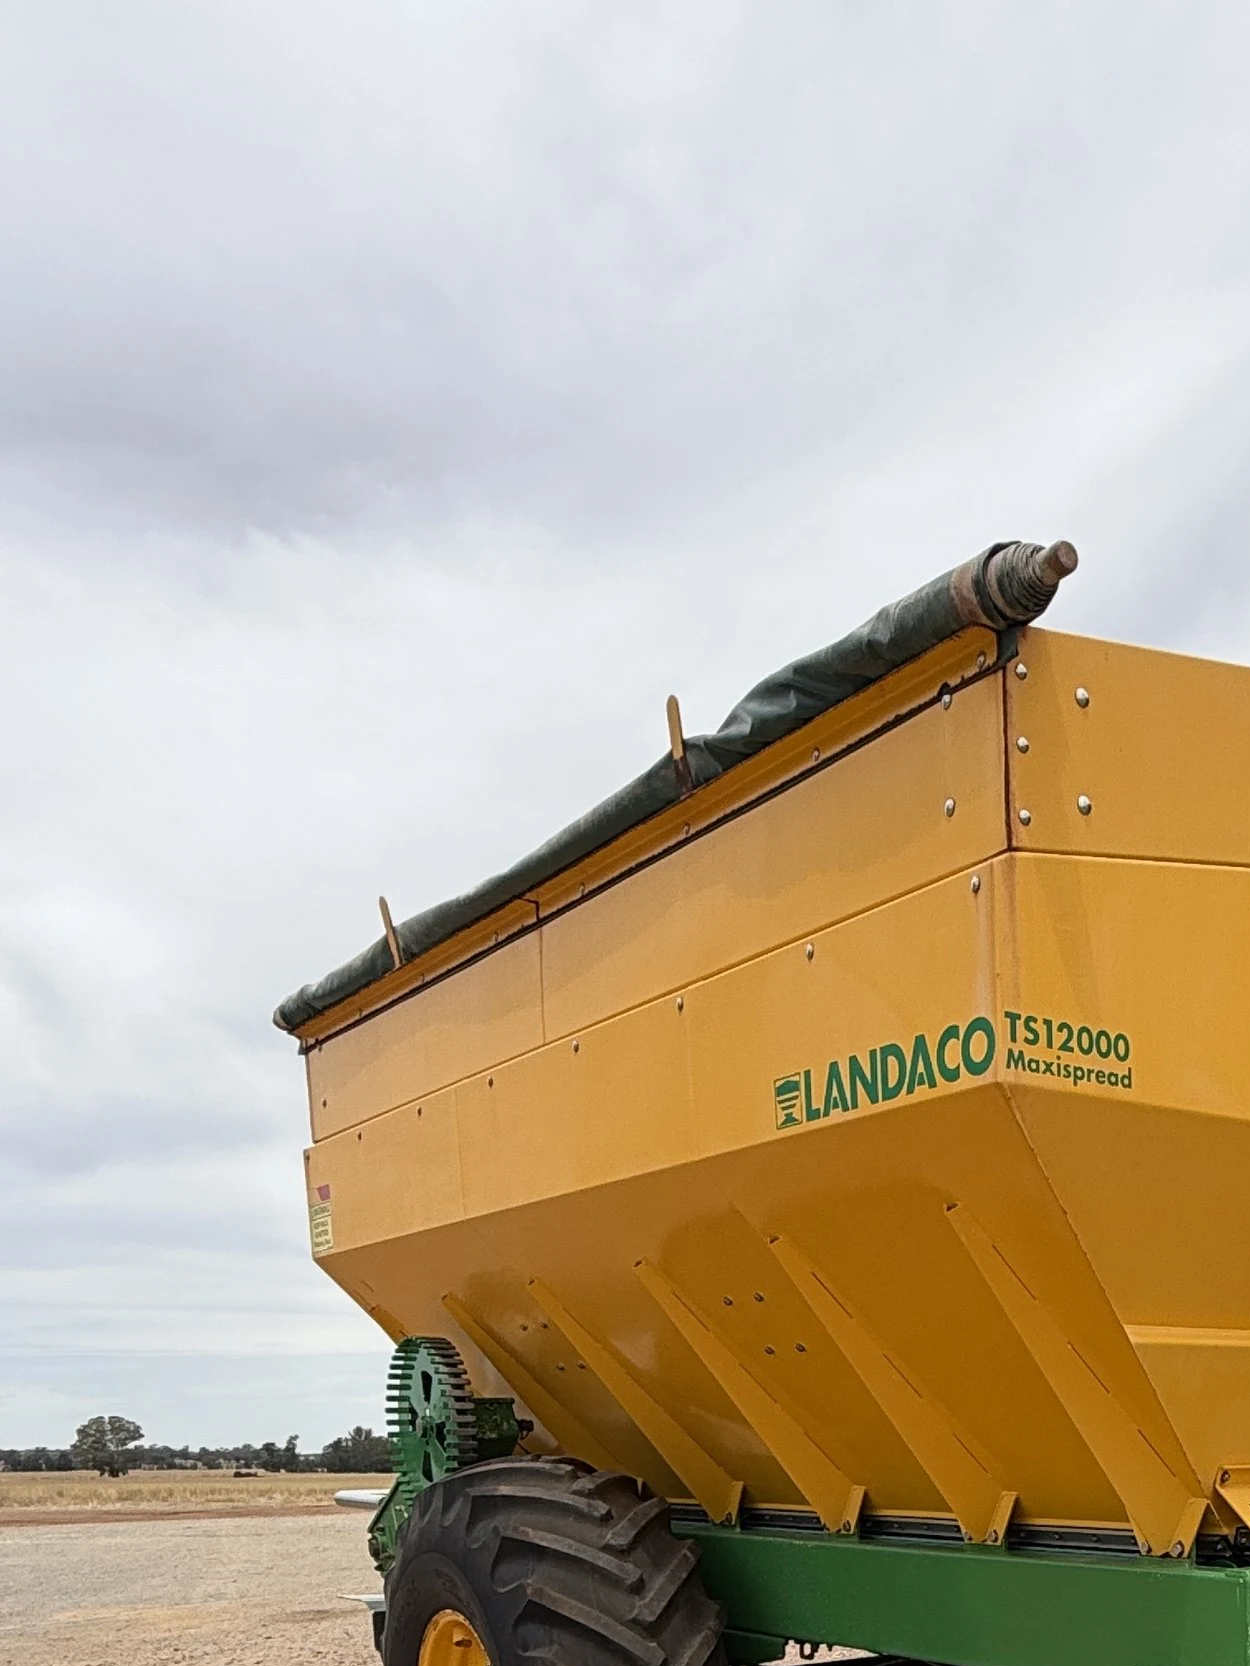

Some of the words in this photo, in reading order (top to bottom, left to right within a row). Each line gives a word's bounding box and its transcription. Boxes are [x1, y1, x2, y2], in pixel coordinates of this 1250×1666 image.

[1004, 1011, 1130, 1062] TS12000
[803, 1016, 996, 1122] LANDACO
[1006, 1048, 1132, 1089] Maxispread
